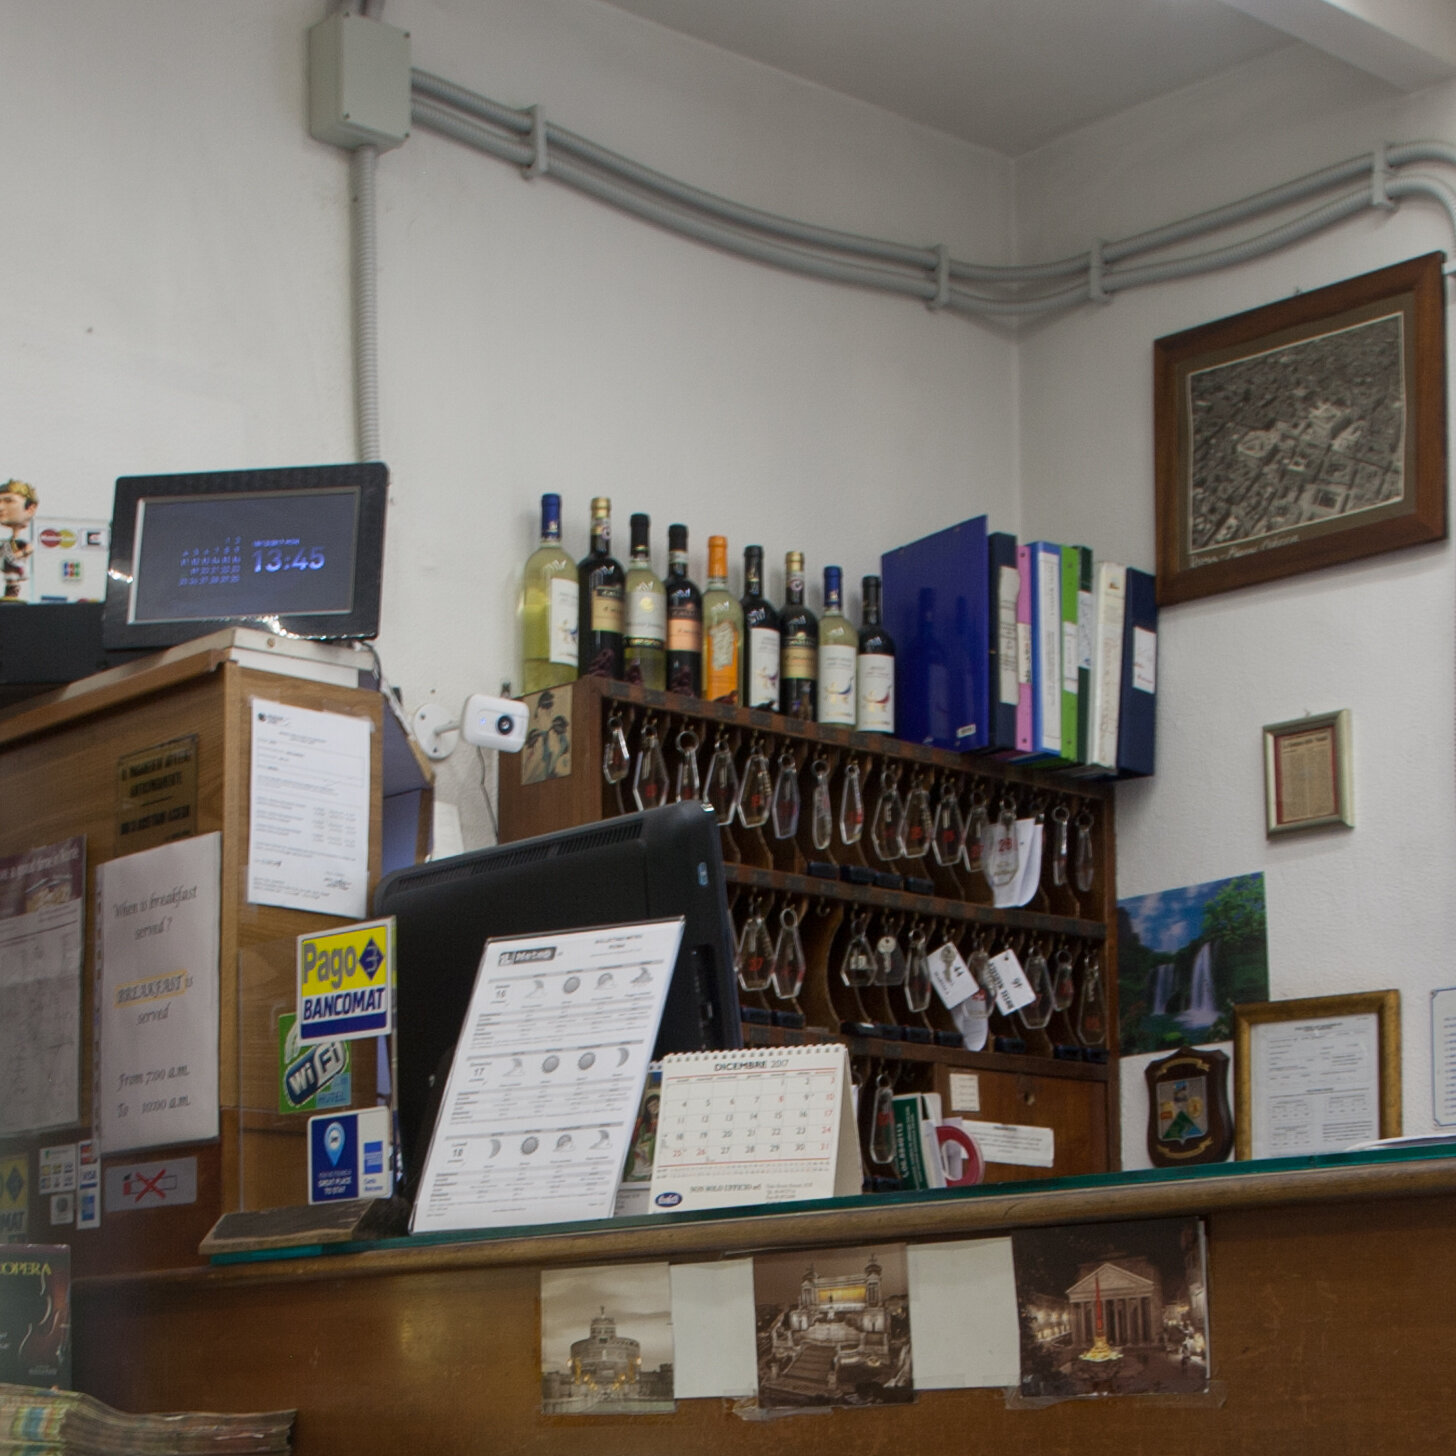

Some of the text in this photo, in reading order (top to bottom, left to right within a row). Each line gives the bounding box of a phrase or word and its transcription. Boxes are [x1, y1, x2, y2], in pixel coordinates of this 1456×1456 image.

[252, 546, 326, 573] 13:45
[303, 942, 358, 989] Pago
[117, 975, 184, 1004] BREAKFAST
[303, 986, 386, 1021] BANCOMAT
[714, 1060, 768, 1072] DICEMBRE
